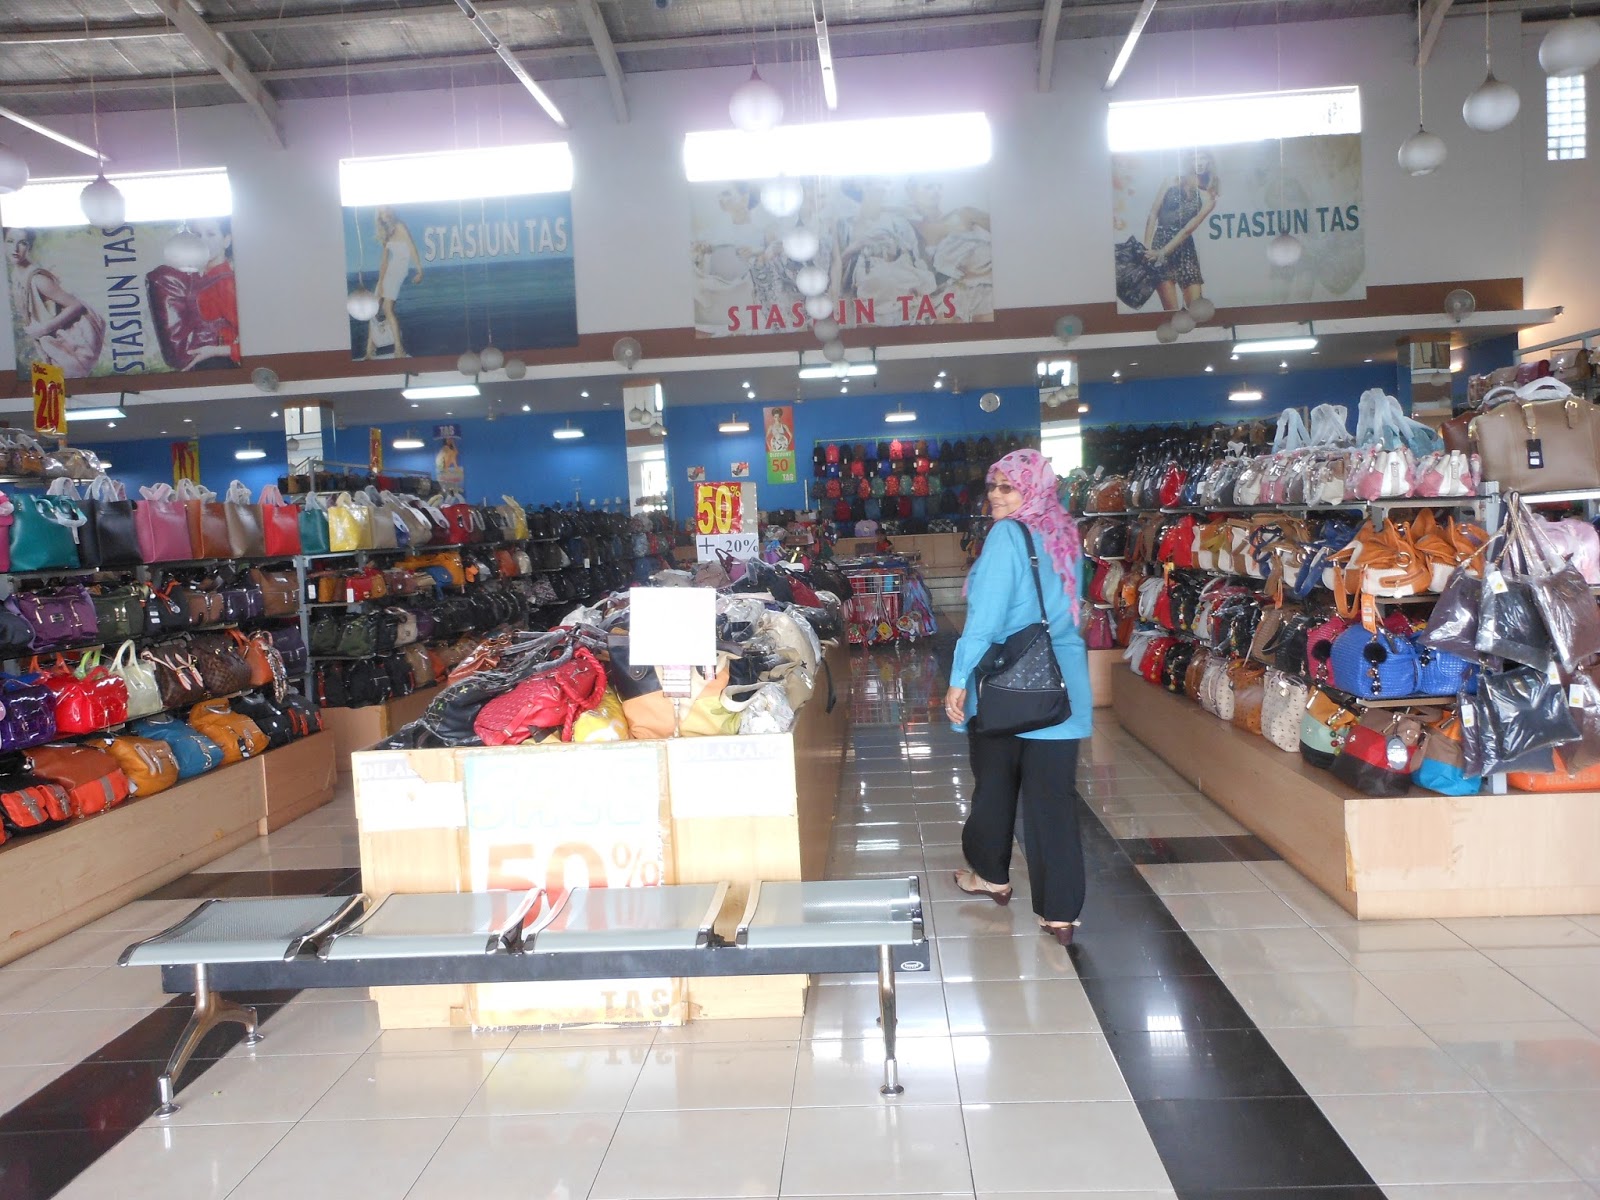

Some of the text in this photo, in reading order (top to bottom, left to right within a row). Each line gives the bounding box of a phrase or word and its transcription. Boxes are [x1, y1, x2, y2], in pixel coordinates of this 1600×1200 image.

[424, 217, 568, 262] STASIUN TAS
[1208, 205, 1360, 241] STASIUN TAS
[102, 225, 146, 373] STASIUN TAS
[727, 293, 956, 332] STASUN TAS
[772, 458, 788, 472] 50
[697, 485, 741, 534] 50%
[725, 538, 759, 553] 20%
[600, 988, 671, 1019] TAS
